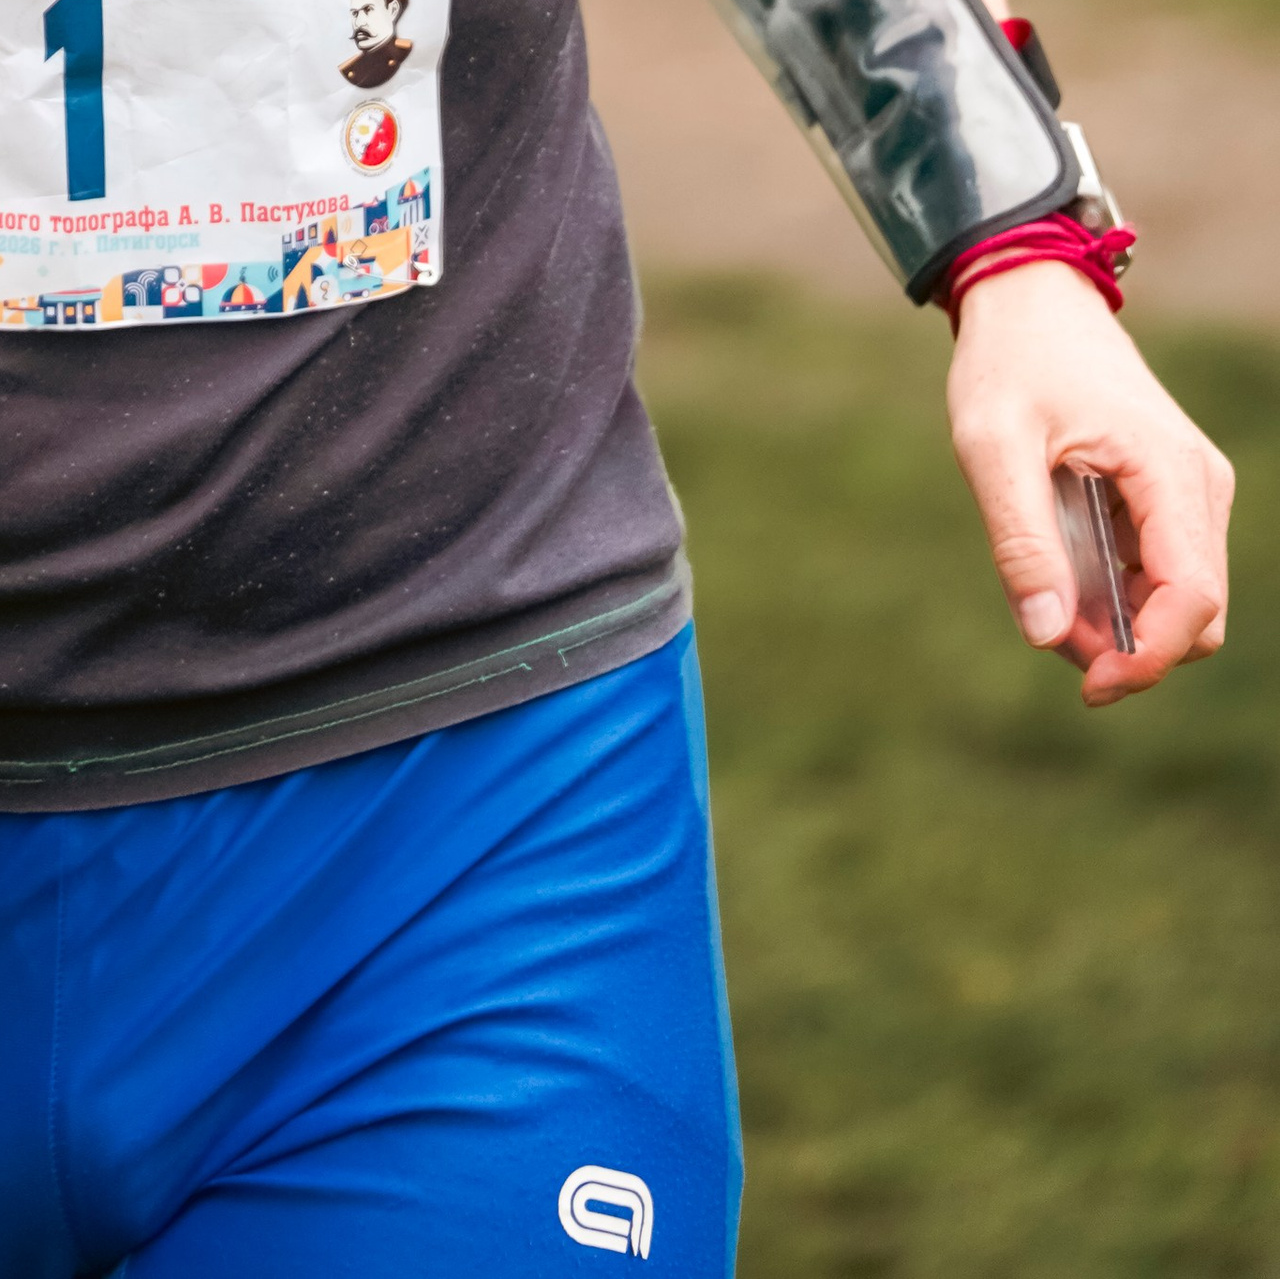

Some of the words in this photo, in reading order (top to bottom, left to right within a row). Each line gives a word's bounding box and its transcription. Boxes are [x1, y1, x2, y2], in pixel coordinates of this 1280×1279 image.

[50, 205, 169, 233] топографа
[178, 205, 198, 225] А.
[209, 203, 230, 223] В.
[240, 194, 350, 224] Пастухова
